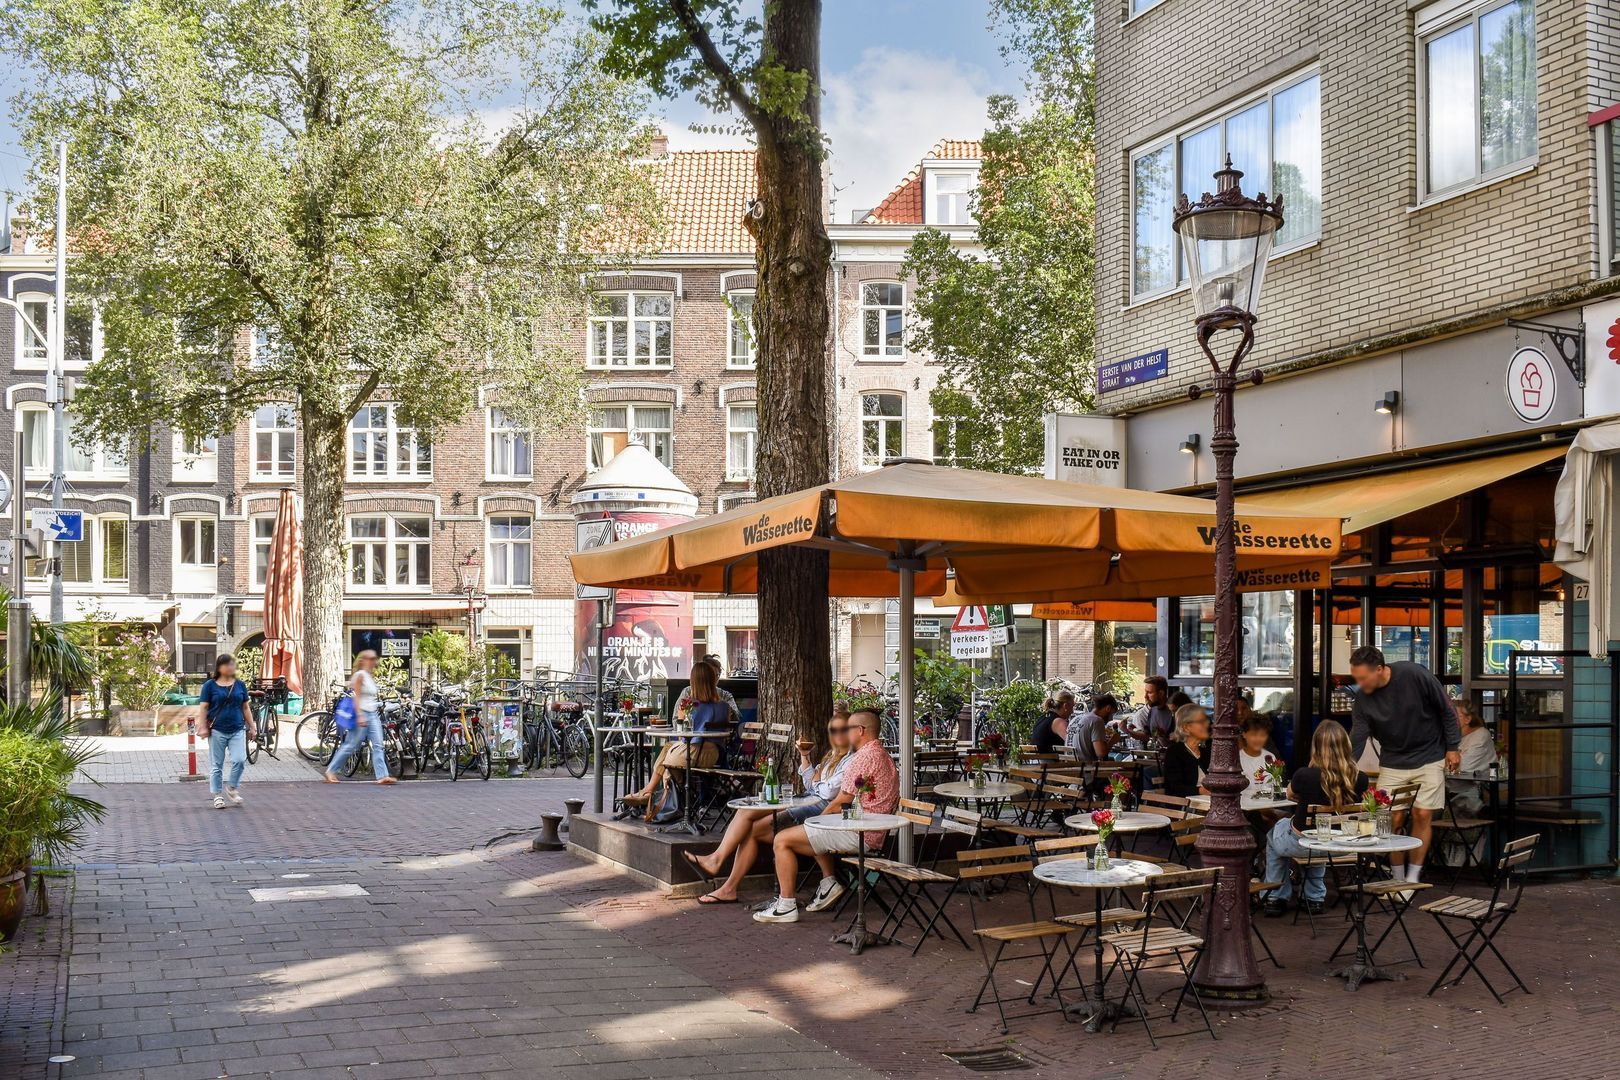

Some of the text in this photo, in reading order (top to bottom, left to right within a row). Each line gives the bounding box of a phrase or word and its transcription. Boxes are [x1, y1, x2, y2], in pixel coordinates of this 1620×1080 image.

[1102, 353, 1162, 379] EERSTE VAN DER HELST
[1102, 376, 1120, 389] STRAAT
[1062, 447, 1120, 460] EAT IN OR
[1062, 457, 1119, 470] TAKE OUT
[758, 514, 770, 528] de
[743, 515, 813, 546] Wasserette
[1576, 586, 1589, 599] 27
[607, 636, 664, 647] ORANJE IS
[952, 633, 988, 643] verkeers-
[587, 646, 683, 657] NIETY MINUTES OF
[956, 646, 988, 657] regelaar
